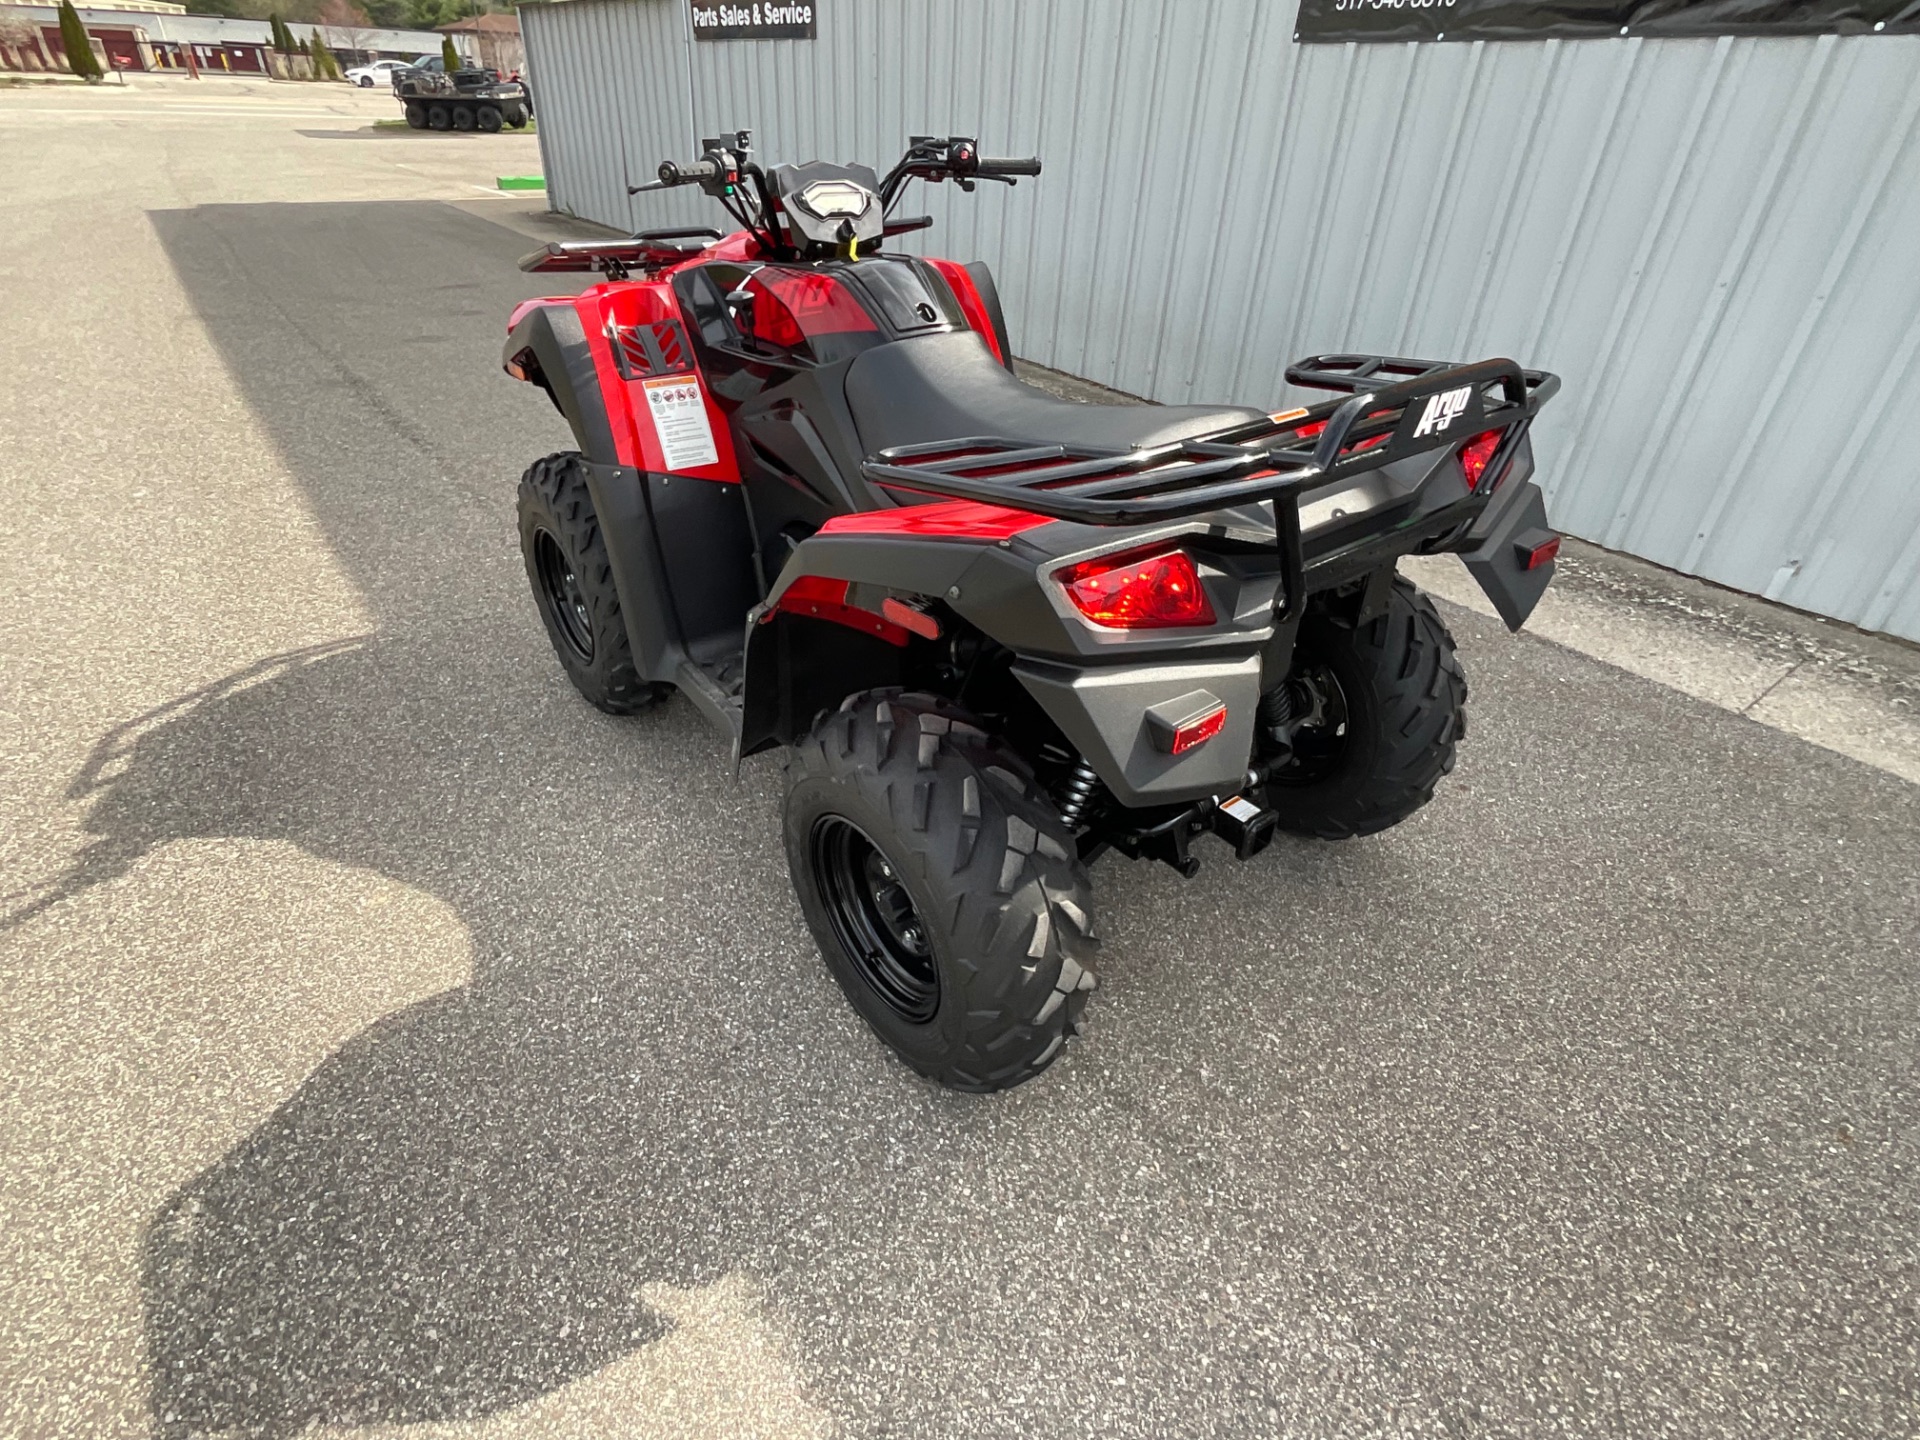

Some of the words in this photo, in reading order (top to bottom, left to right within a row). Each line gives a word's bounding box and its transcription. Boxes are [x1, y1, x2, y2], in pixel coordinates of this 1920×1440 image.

[693, 7, 718, 27] Parts
[719, 4, 750, 26] Sales
[752, 3, 762, 25] &
[764, 1, 812, 24] Service
[1412, 386, 1472, 438] Argo
